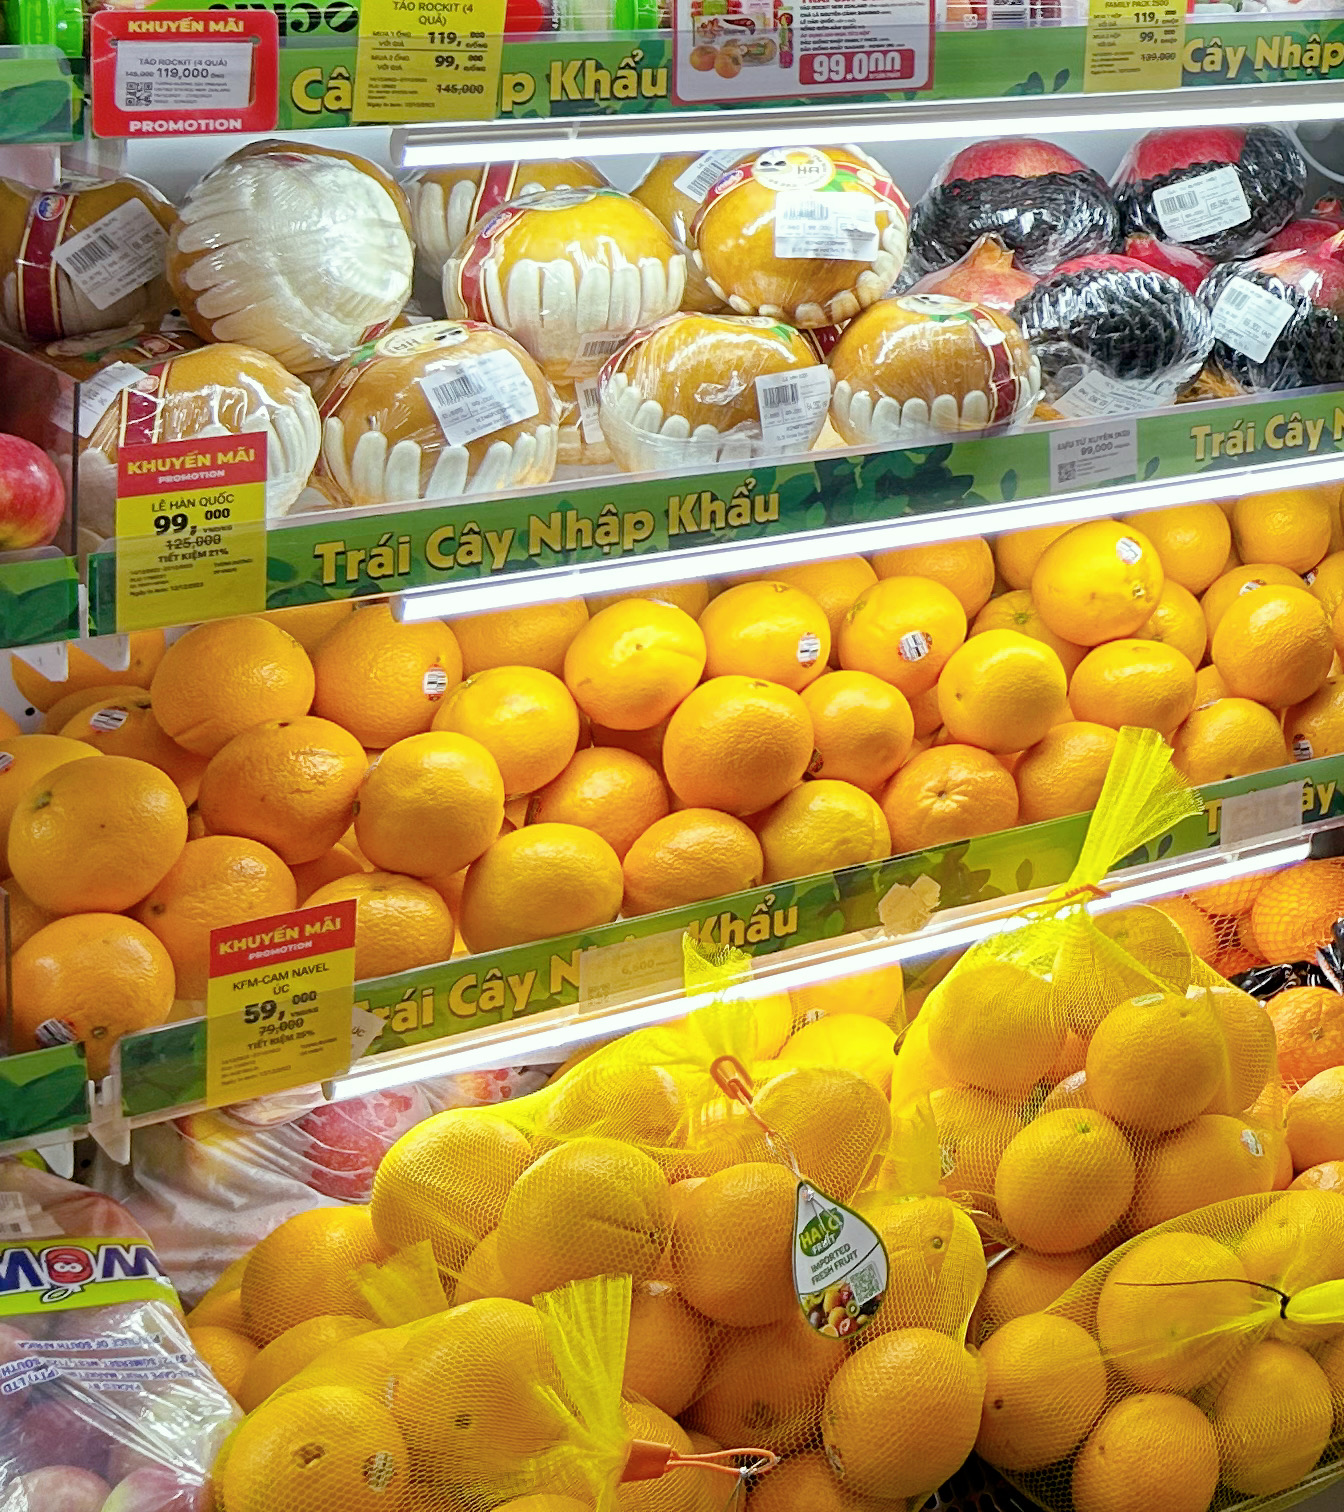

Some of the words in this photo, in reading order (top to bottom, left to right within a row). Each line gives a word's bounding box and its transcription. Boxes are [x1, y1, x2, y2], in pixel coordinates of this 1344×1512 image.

[128, 16, 204, 33] KHUYẾN
[209, 18, 245, 33] MÃI
[156, 67, 209, 81] 119,000
[550, 47, 669, 102] Khẩu
[1181, 35, 1248, 83] Cây
[129, 119, 242, 133] PROMOTION
[1190, 419, 1263, 462] Trái
[1267, 408, 1327, 456] Cây
[127, 449, 212, 476] KHUYẾN
[216, 445, 256, 466] MÃI
[157, 469, 226, 485] PROMOTION
[169, 496, 196, 511] HÀN
[198, 490, 236, 508] QUỐC
[313, 534, 412, 585] Trái
[424, 520, 523, 576] Cây
[529, 500, 656, 558] Nhập
[668, 478, 781, 534] Khẩu
[219, 925, 300, 955] KHUYẾN
[304, 915, 342, 937] MÃI
[248, 940, 313, 961] PROMOTION
[291, 962, 330, 980] NAVEL
[447, 972, 540, 1020] Cây
[810, 1242, 852, 1274] IMPORTED
[811, 1264, 835, 1286] FRESH
[833, 1248, 859, 1273] FRUIT
